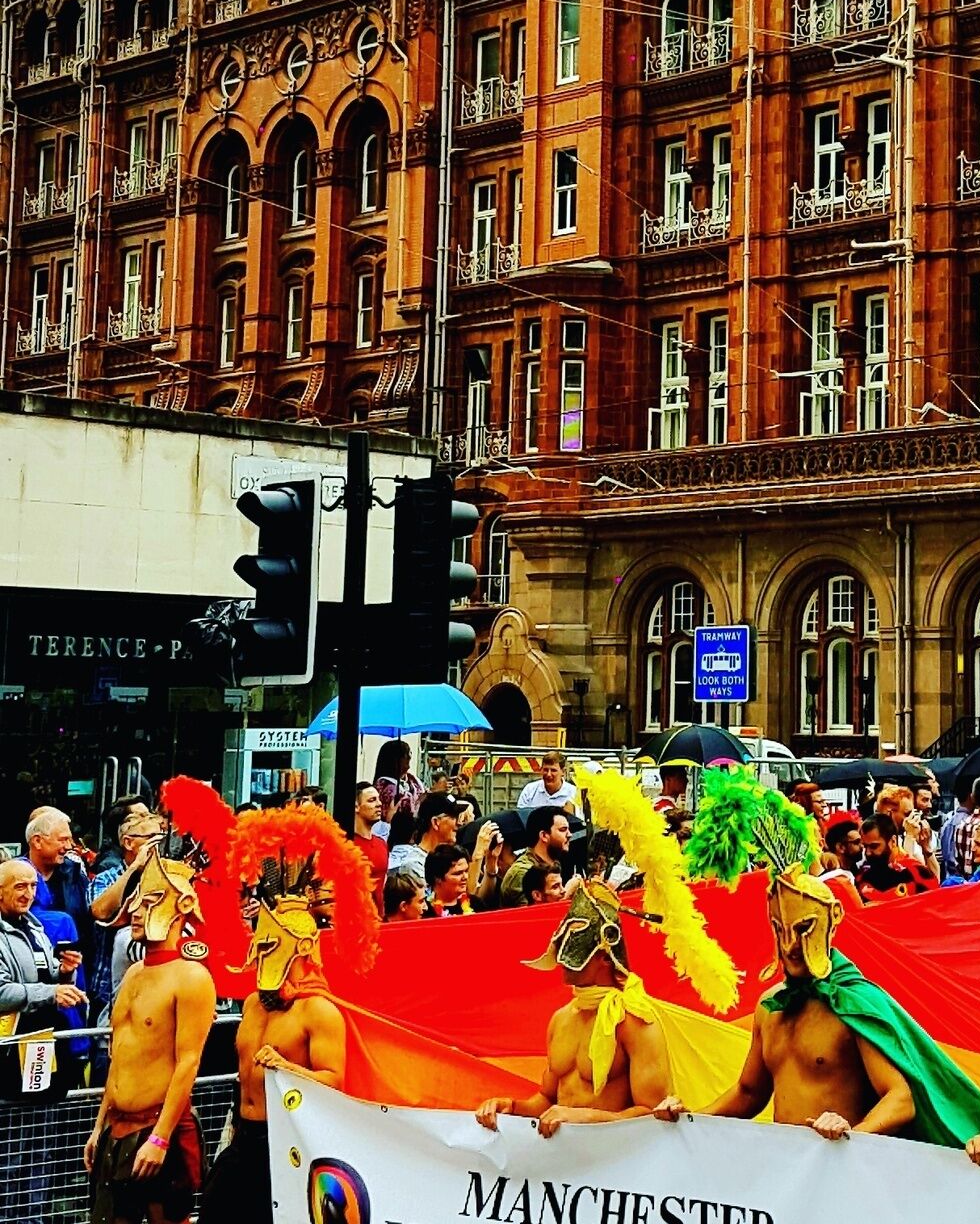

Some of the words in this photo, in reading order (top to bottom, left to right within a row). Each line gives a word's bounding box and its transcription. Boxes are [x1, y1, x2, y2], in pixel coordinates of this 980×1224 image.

[702, 631, 742, 642] TRAMWAY
[29, 634, 147, 659] TERENCE
[169, 639, 194, 660] PA
[698, 676, 720, 686] LOOK
[722, 676, 745, 686] BOTH
[709, 687, 733, 697] WAYS
[259, 730, 308, 742] SYSTEM
[33, 1046, 47, 1090] swinton
